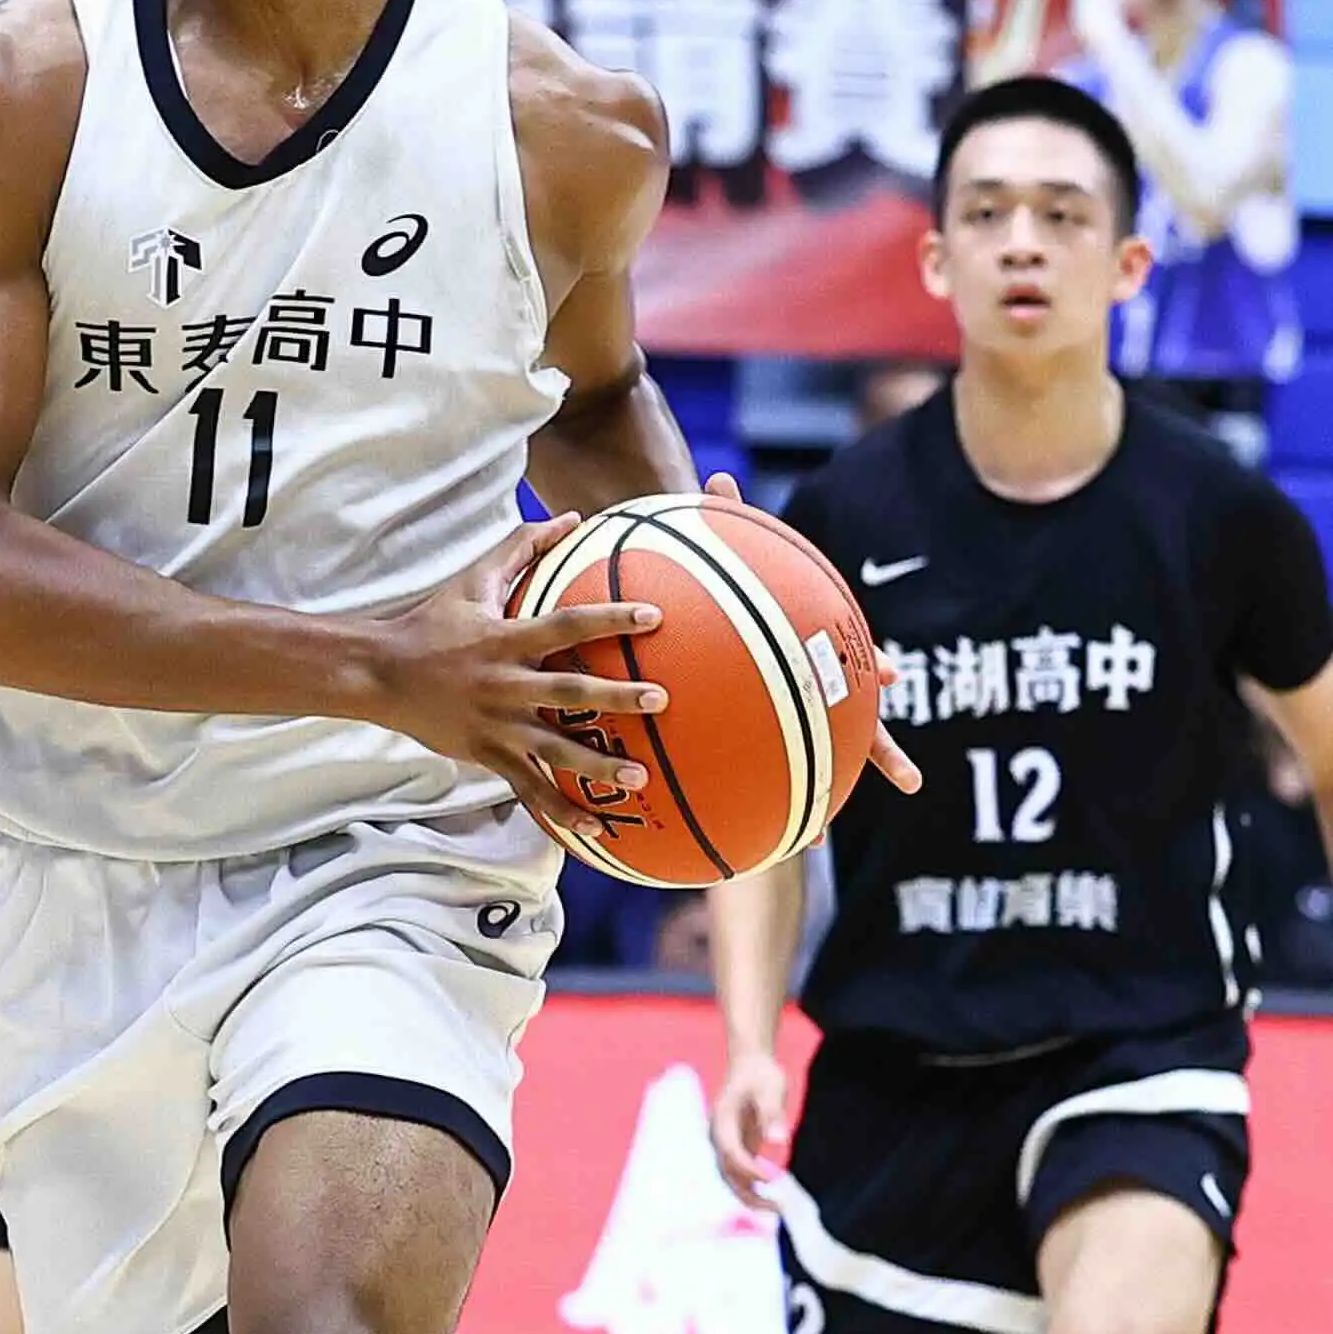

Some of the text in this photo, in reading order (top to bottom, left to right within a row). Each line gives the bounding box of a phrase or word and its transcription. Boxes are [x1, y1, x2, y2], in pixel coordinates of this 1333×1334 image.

[187, 387, 279, 528] 11
[879, 623, 1156, 727] 南湖高中
[966, 746, 1062, 843] 12
